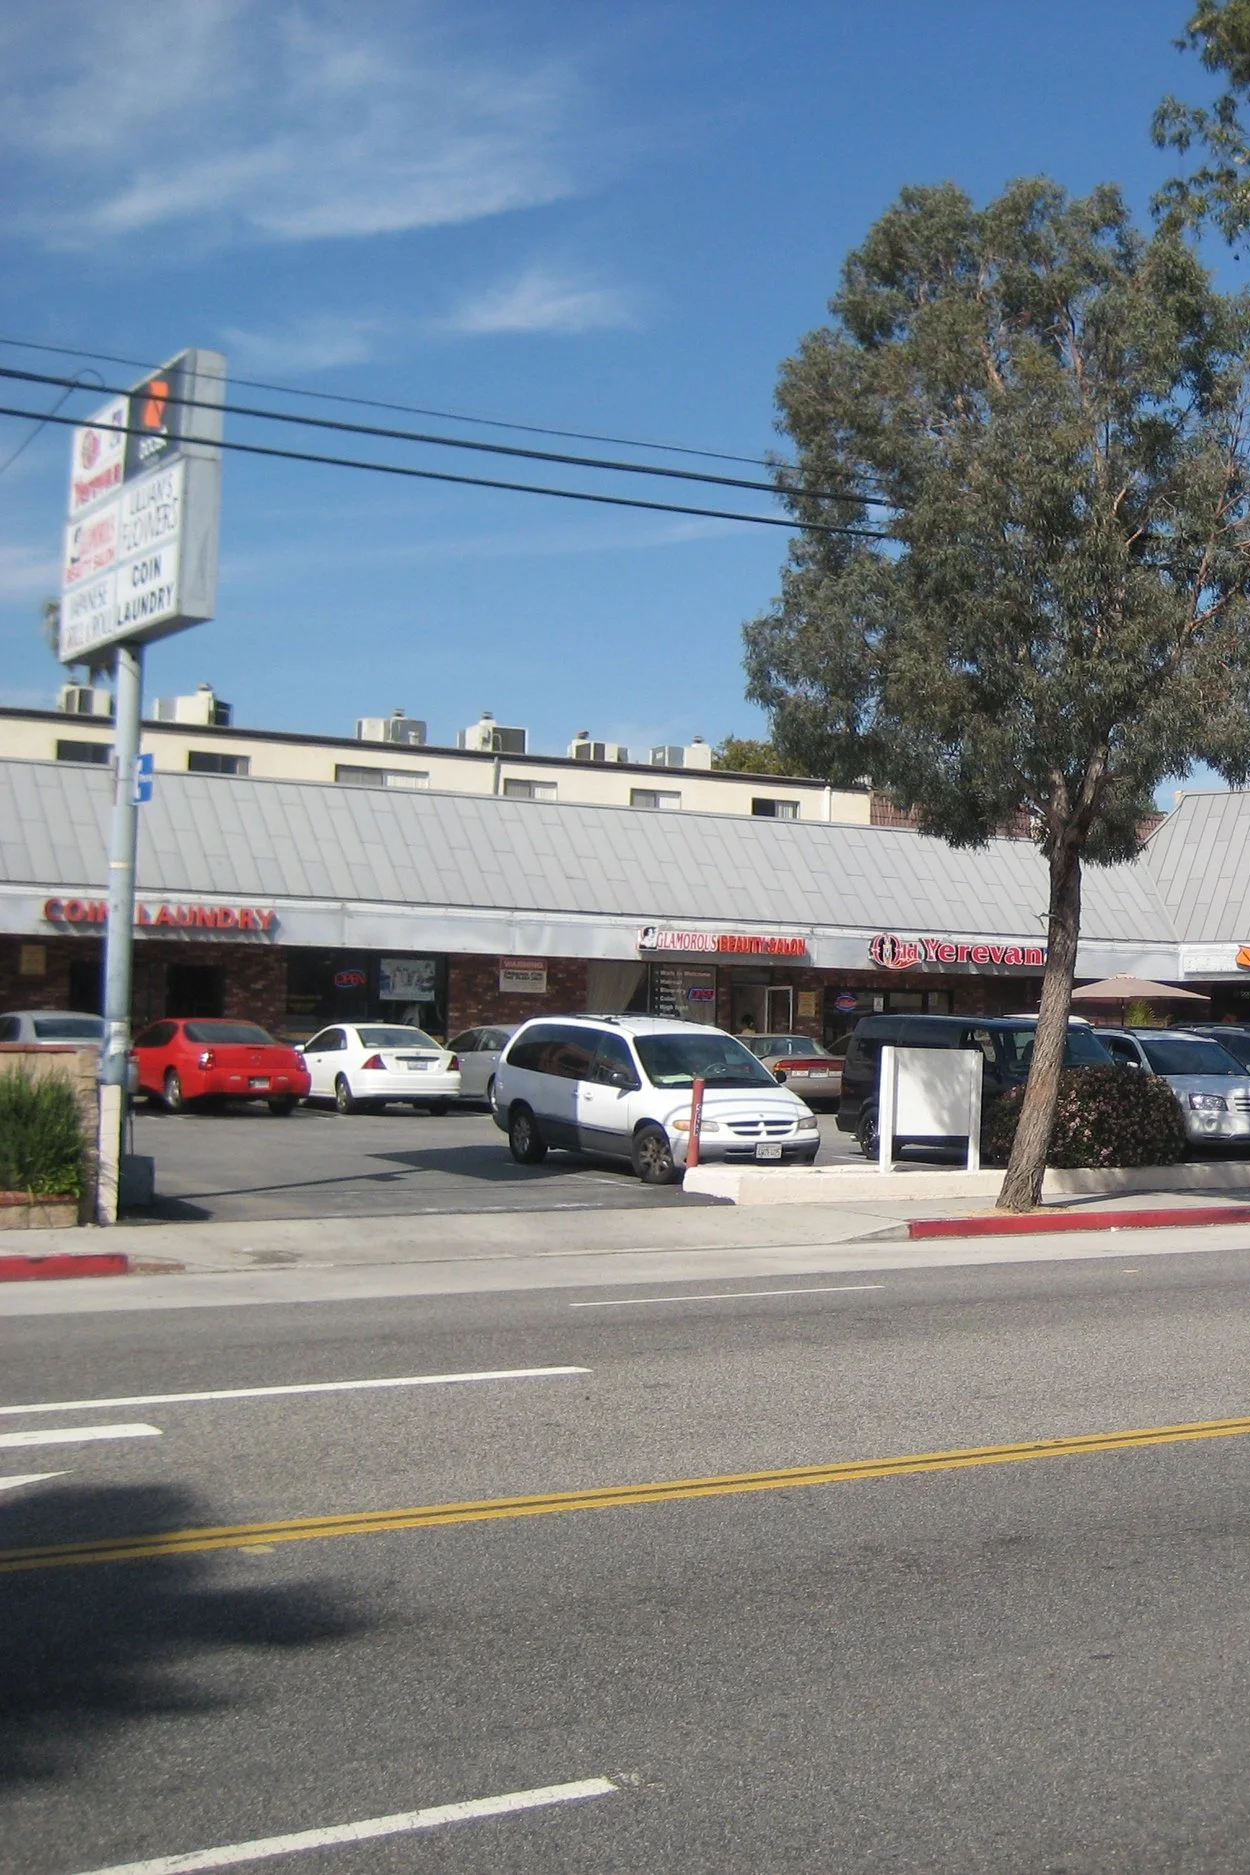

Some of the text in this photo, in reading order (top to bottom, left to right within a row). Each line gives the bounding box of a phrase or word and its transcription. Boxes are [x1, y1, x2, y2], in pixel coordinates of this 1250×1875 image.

[122, 501, 178, 551] FLOWERS
[132, 555, 161, 587] COIN
[117, 584, 174, 626] LAUNDRY
[137, 903, 275, 930] LAUNDRY
[657, 931, 806, 955] GLAMOROUS BEAUTY SALON
[923, 938, 1045, 966] Yerevan
[337, 972, 368, 985] OPEN
